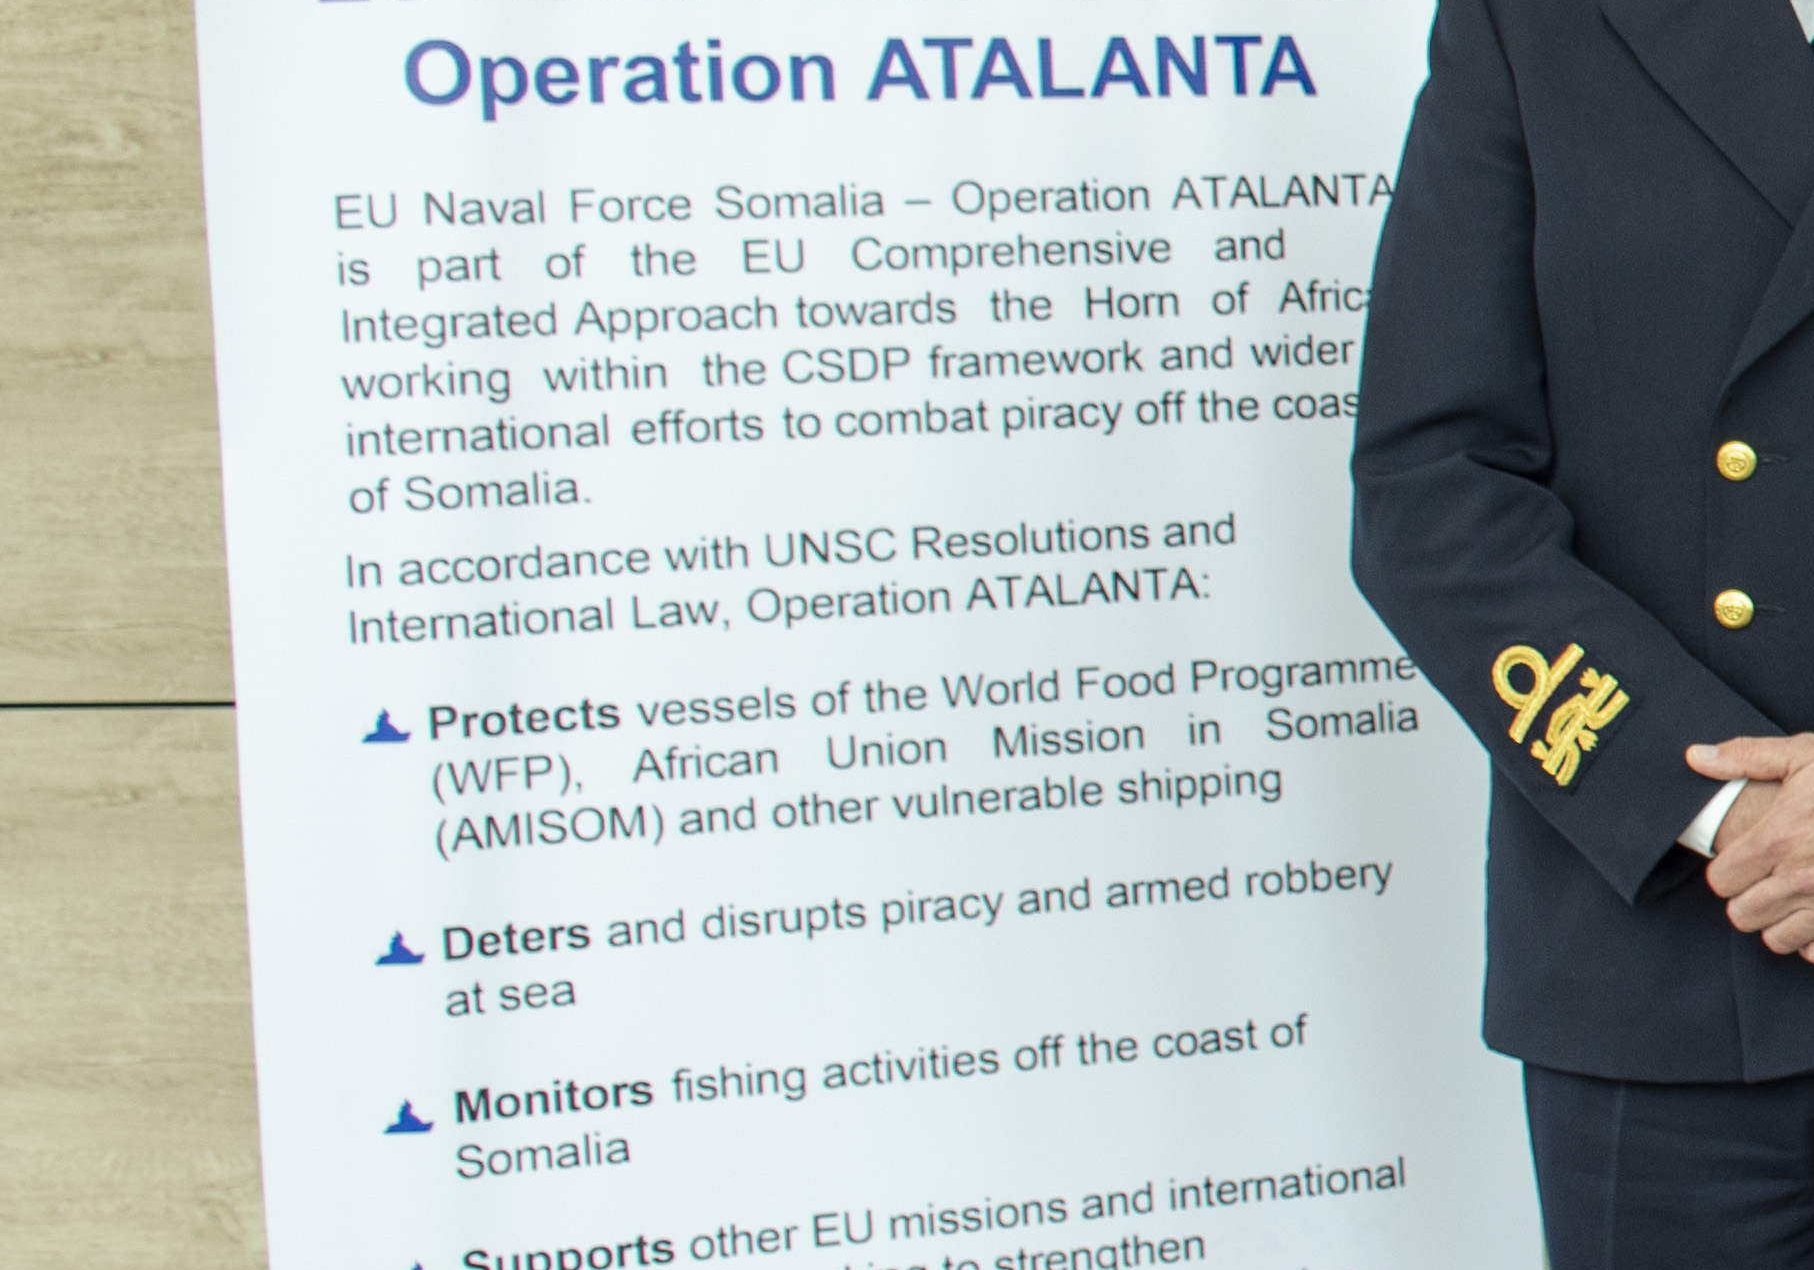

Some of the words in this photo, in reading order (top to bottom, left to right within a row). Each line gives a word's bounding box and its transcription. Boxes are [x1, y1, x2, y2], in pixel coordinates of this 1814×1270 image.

[404, 37, 836, 123] Operation
[866, 34, 1318, 102] ATALANTA
[335, 193, 397, 230] EU
[424, 190, 545, 226] Naval
[570, 188, 692, 223] Force
[715, 183, 885, 220] Somalia
[952, 178, 1150, 222] Operation
[1172, 172, 1395, 210] ATALANTA
[338, 252, 370, 286] is
[417, 247, 502, 291] part
[545, 243, 586, 280] of
[630, 242, 696, 277] the
[742, 238, 805, 274] EU
[851, 231, 1172, 277] Comprehensive
[1214, 227, 1286, 262] and
[342, 302, 557, 349] Integrated
[574, 295, 778, 343] Approach
[795, 291, 957, 329] towards
[989, 288, 1053, 323] the
[1085, 285, 1180, 320] Horn
[1211, 280, 1250, 316] of
[1278, 278, 1371, 314] Afric
[341, 361, 511, 405] working
[543, 355, 668, 392] within
[701, 352, 767, 387] the
[782, 346, 911, 385] CSDP
[928, 339, 1144, 379] framework
[1160, 335, 1233, 372] and
[1250, 333, 1355, 368] wider
[347, 412, 610, 457] international
[631, 408, 764, 446] efforts
[782, 407, 822, 440] to
[835, 399, 990, 438] combat
[1002, 396, 1123, 439] piracy
[1135, 389, 1187, 426] off
[1197, 389, 1260, 424] the
[1272, 392, 1360, 421] coas
[349, 476, 390, 514] of
[405, 471, 591, 511] Somalia.
[346, 554, 382, 588] In
[399, 544, 650, 586] accordance
[664, 535, 749, 572] with
[765, 527, 897, 568] UNSC
[912, 519, 1151, 560] Resolutions
[1163, 511, 1236, 548] and
[349, 596, 614, 644] International
[632, 595, 730, 630] Law,
[747, 581, 951, 629] Operation
[966, 566, 1210, 611] ATALANTA:
[428, 698, 621, 741] Protects
[636, 686, 797, 727] vessels
[811, 679, 851, 717] of
[863, 679, 928, 714] the
[941, 669, 1060, 709] World
[1076, 662, 1176, 700] Food
[1191, 656, 1416, 698] Programme
[432, 754, 582, 805] (WFP),
[632, 745, 779, 783] African
[827, 732, 947, 770] Union
[993, 720, 1145, 759] Mission
[1188, 713, 1221, 746] in
[1266, 700, 1419, 742] Somalia
[436, 804, 665, 862] (AMISOM)
[679, 796, 757, 836] and
[772, 792, 880, 829] other
[891, 774, 1104, 820] vulnerable
[1117, 764, 1282, 809] shipping
[442, 922, 592, 962] Deters
[607, 908, 686, 948] and
[701, 898, 867, 940] disrupts
[881, 890, 1004, 934] piracy
[1017, 877, 1091, 916] and
[1106, 866, 1230, 909] armed
[1245, 859, 1393, 897] robbery
[445, 981, 486, 1018] at
[499, 980, 576, 1012] sea
[454, 1079, 654, 1125] Monitors
[671, 1063, 807, 1102] fishing
[823, 1045, 1000, 1090] activities
[1013, 1033, 1065, 1072] off
[1076, 1032, 1138, 1066] the
[1152, 1019, 1258, 1059] coast
[1270, 1012, 1308, 1049] of
[456, 1132, 631, 1180] Somalia
[689, 1223, 799, 1261] other
[812, 1209, 873, 1248] EU
[889, 1197, 1068, 1240] missions
[1081, 1181, 1154, 1220] and
[1169, 1155, 1406, 1211] international
